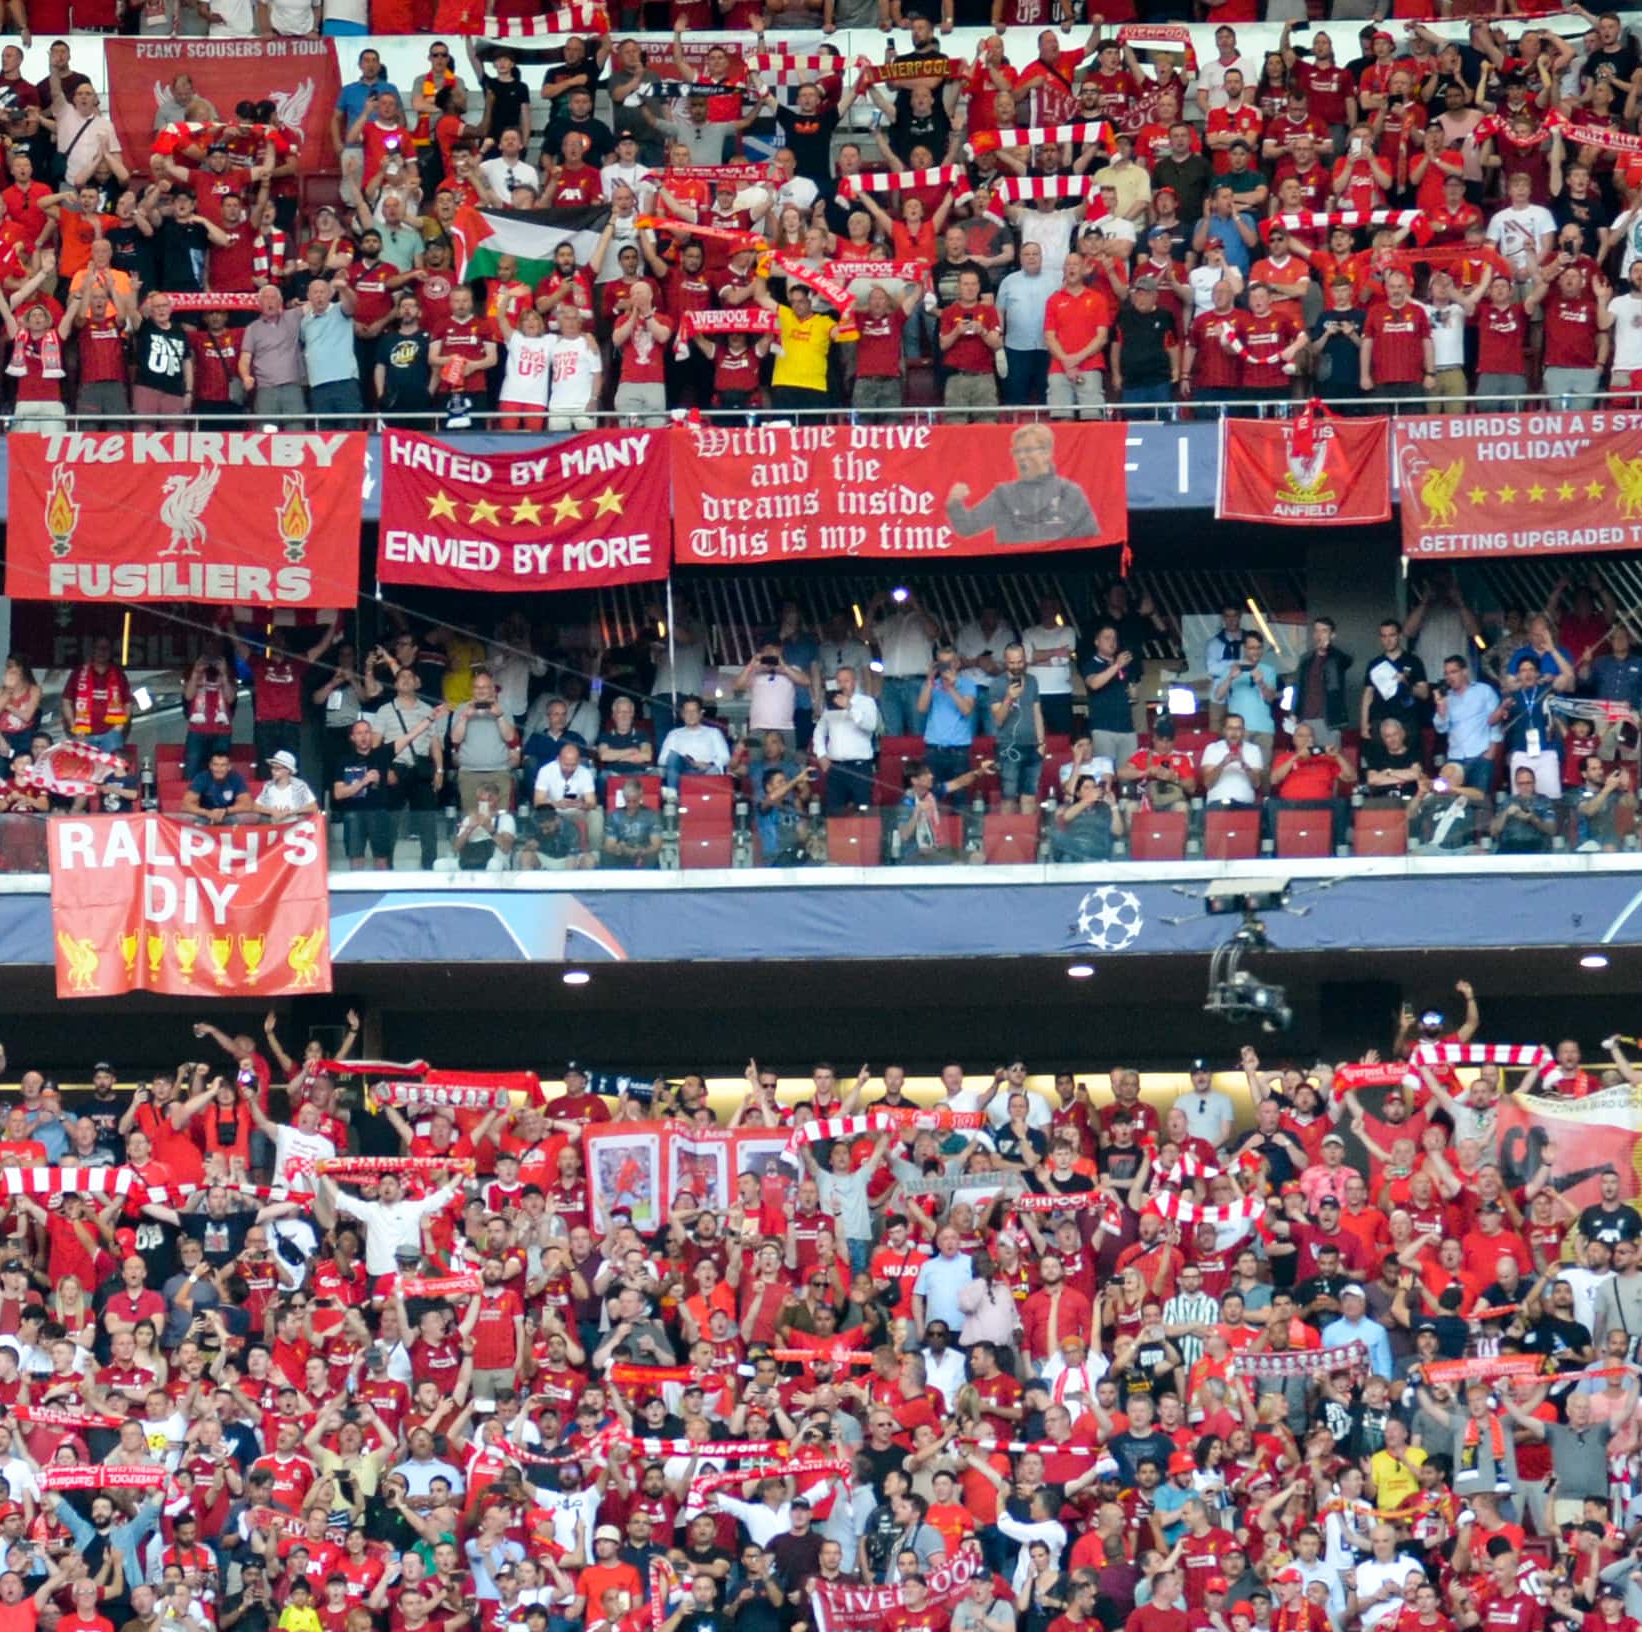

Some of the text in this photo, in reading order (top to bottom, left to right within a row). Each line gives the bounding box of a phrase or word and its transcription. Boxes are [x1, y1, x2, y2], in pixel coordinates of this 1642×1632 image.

[878, 59, 950, 79] LIVERPOOL
[42, 430, 350, 467] The KIRKBY
[693, 423, 931, 458] With the drive
[390, 433, 650, 487] HATED BY MANY
[751, 451, 881, 488] and the
[701, 484, 935, 522] dreams inside
[1272, 502, 1338, 519] ANFIELD
[385, 530, 651, 575] ENVIED BY MORE
[690, 523, 954, 559] This is my time
[50, 561, 312, 602] FUSILIERS
[57, 819, 320, 876] RALPH'S
[142, 875, 238, 925] DIY
